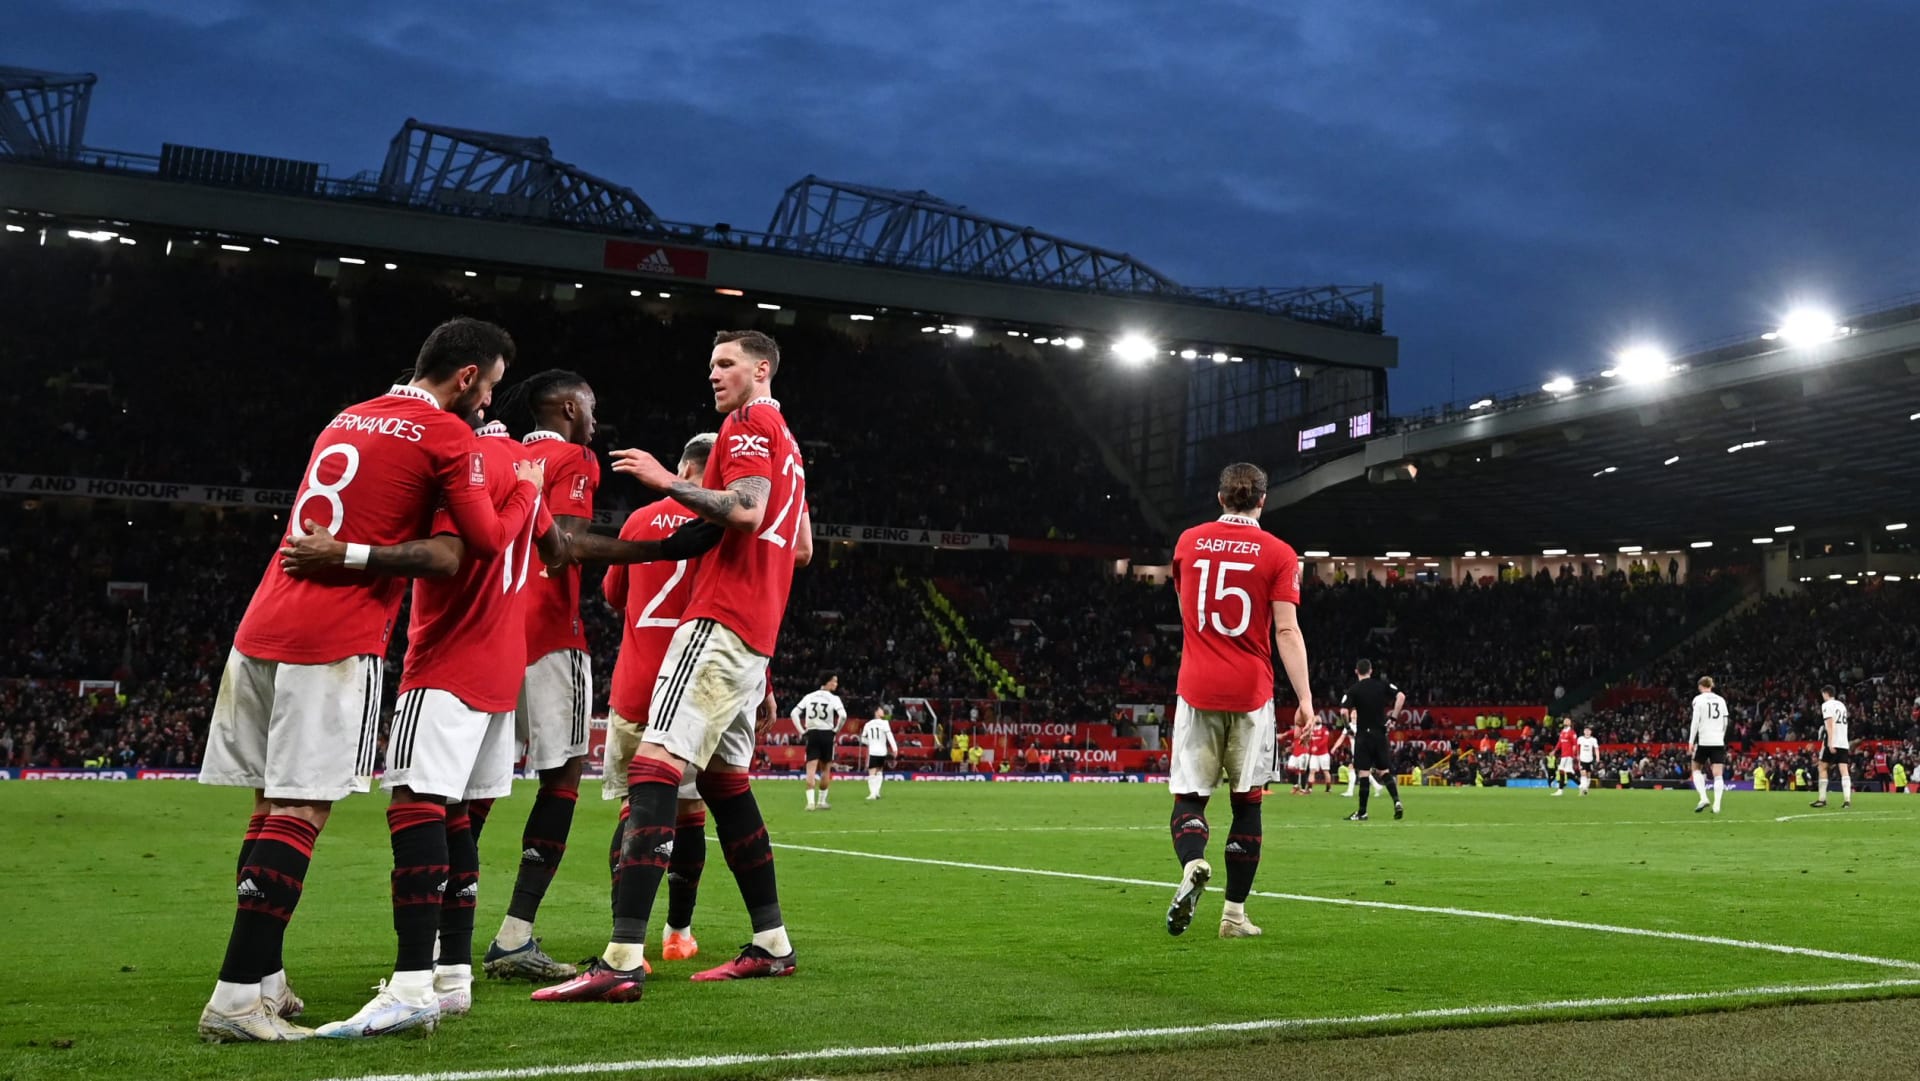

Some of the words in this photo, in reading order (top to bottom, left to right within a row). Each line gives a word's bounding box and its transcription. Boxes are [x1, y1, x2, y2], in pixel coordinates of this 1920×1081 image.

[728, 433, 770, 453] DXC
[29, 476, 76, 491] AND
[87, 480, 189, 499] HONOUR"
[203, 487, 244, 502] THE
[254, 489, 296, 504] GRE
[291, 442, 360, 537] 8
[815, 525, 852, 538] LIKE
[862, 527, 909, 542] BEING
[919, 532, 930, 543] A
[940, 532, 979, 546] RED"
[1194, 538, 1261, 556] SABITZER
[1192, 558, 1256, 638] 15
[808, 702, 829, 720] 33
[1707, 702, 1720, 719] 13
[870, 727, 881, 740] 11
